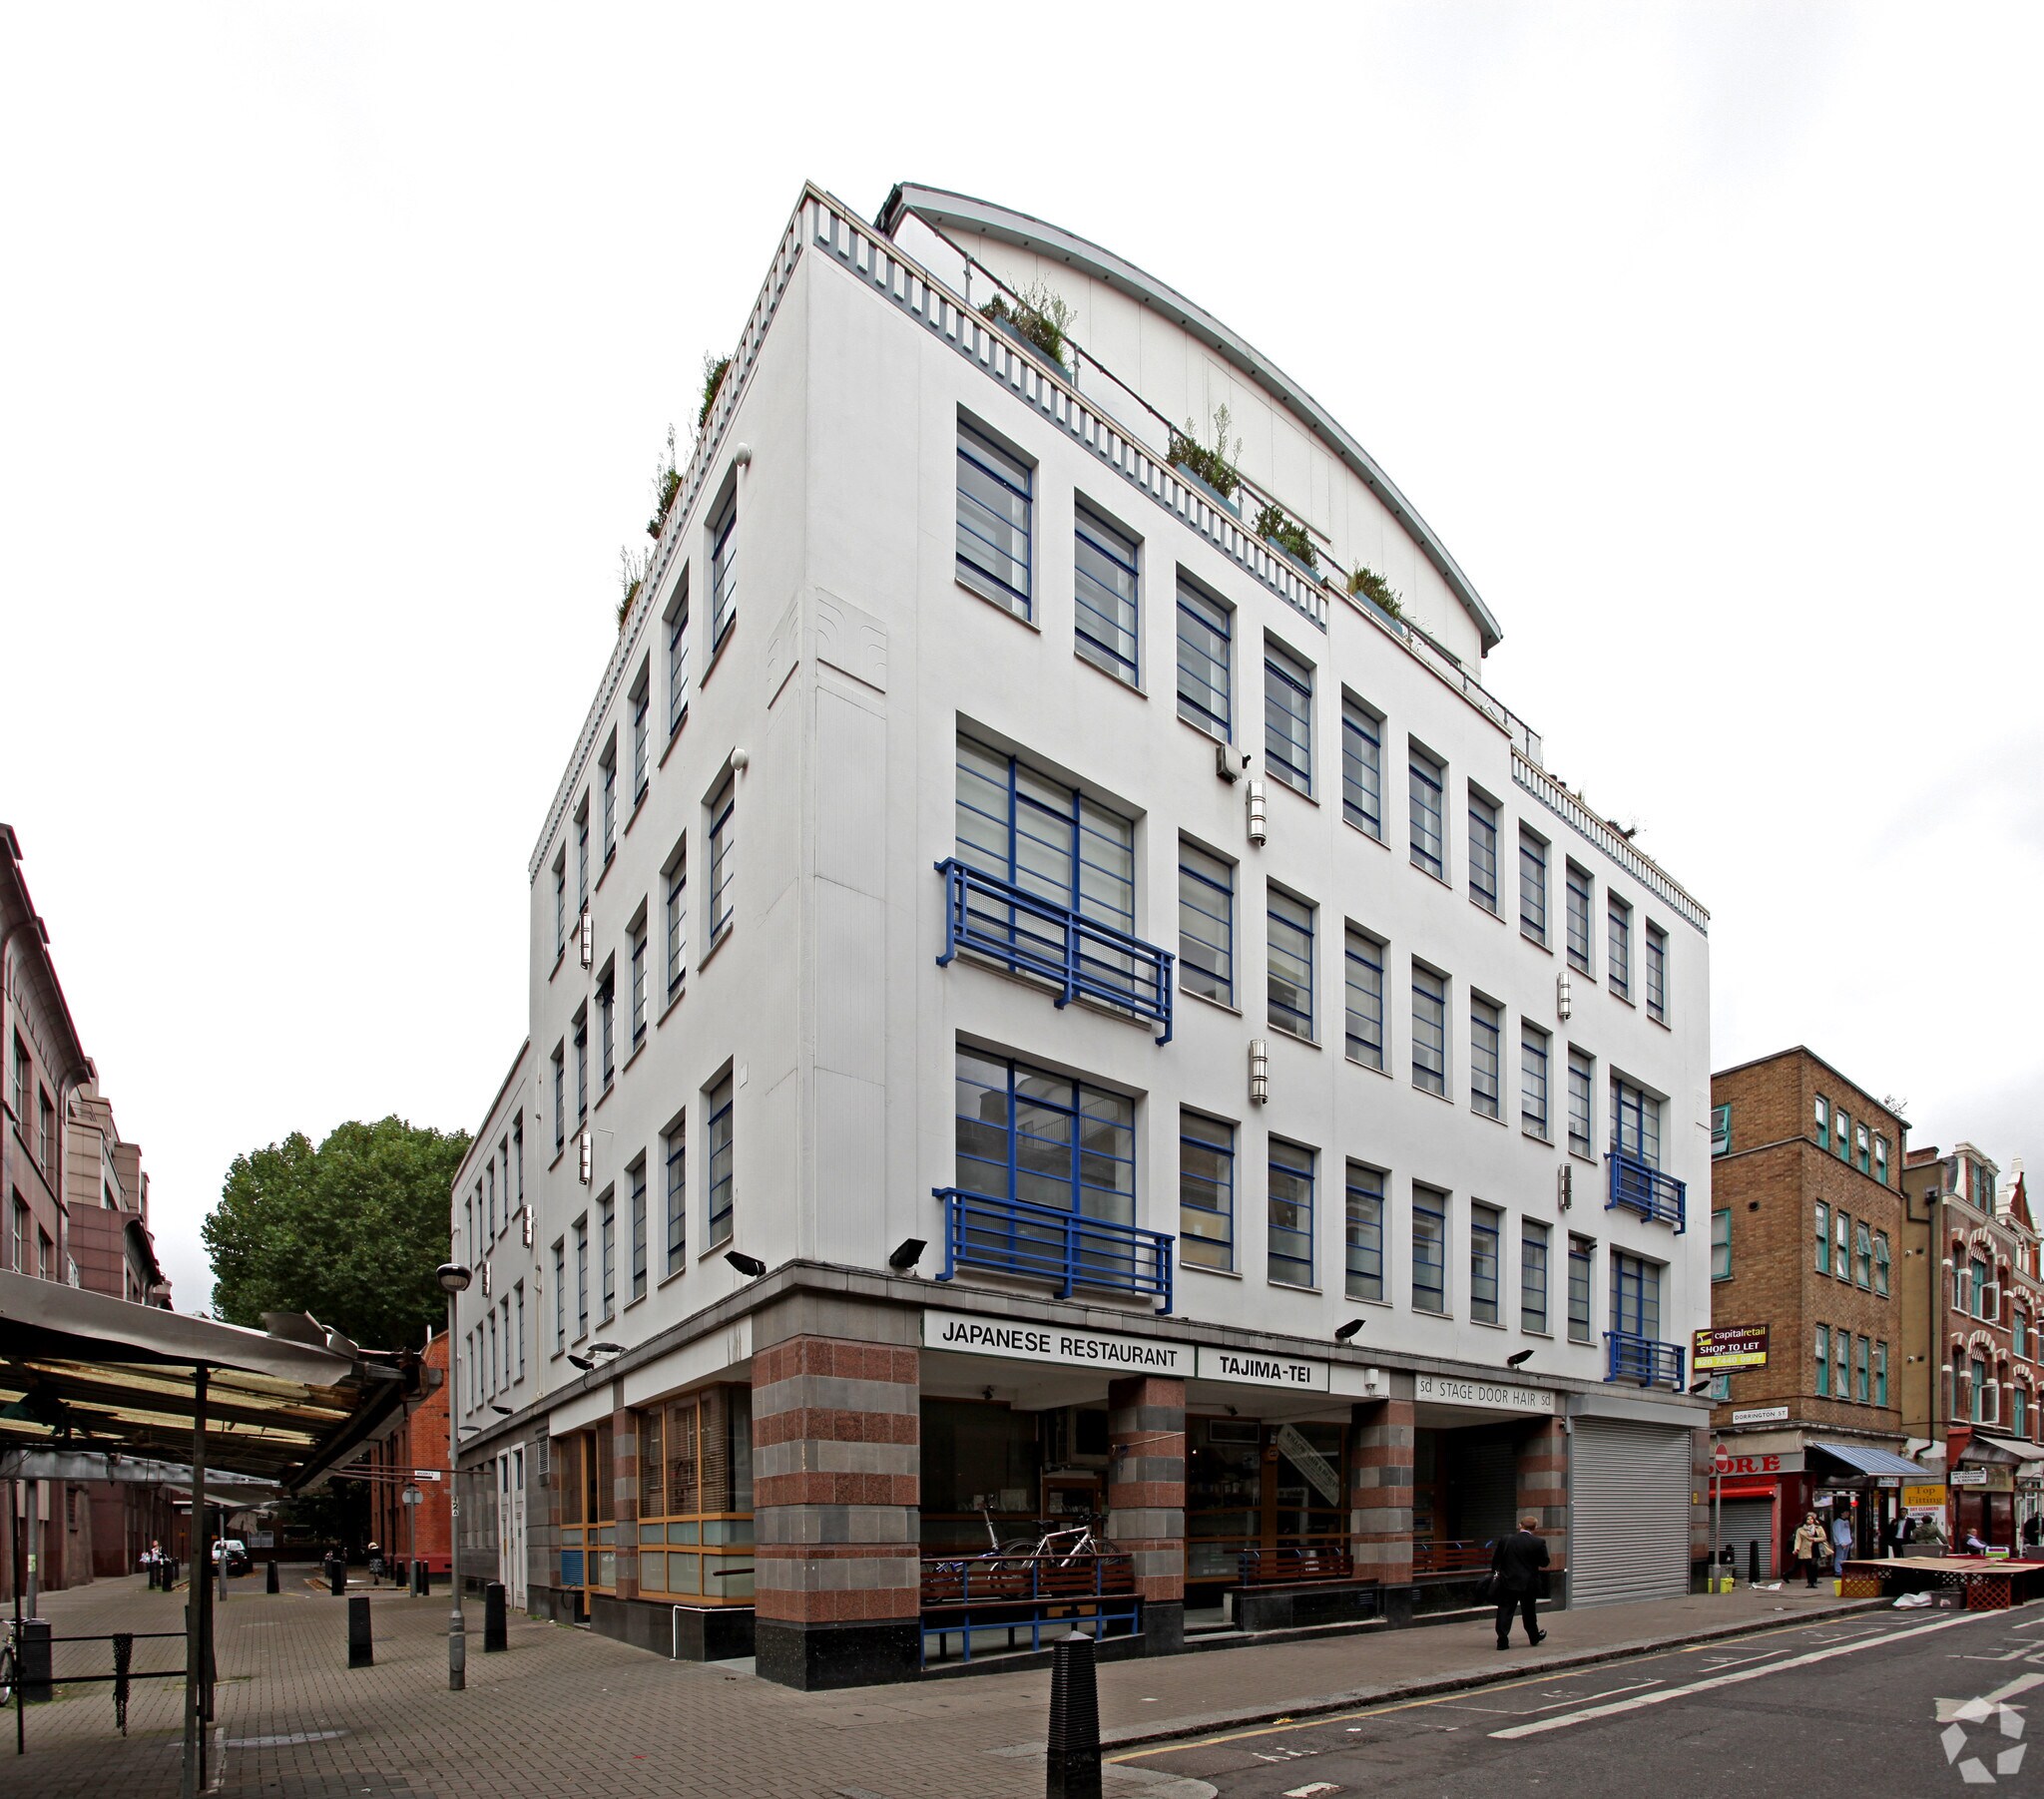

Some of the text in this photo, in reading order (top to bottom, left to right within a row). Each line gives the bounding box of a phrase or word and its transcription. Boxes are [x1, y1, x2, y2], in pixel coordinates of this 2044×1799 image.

[942, 1322, 1178, 1367] JAPANESE RESTAURANT
[1715, 1327, 1766, 1340] capitalretail
[1700, 1345, 1726, 1354] SHOP
[1220, 1356, 1310, 1383] TAJIMA-TEI
[1420, 1377, 1551, 1406] sd STAGE DOOR HAIR sd
